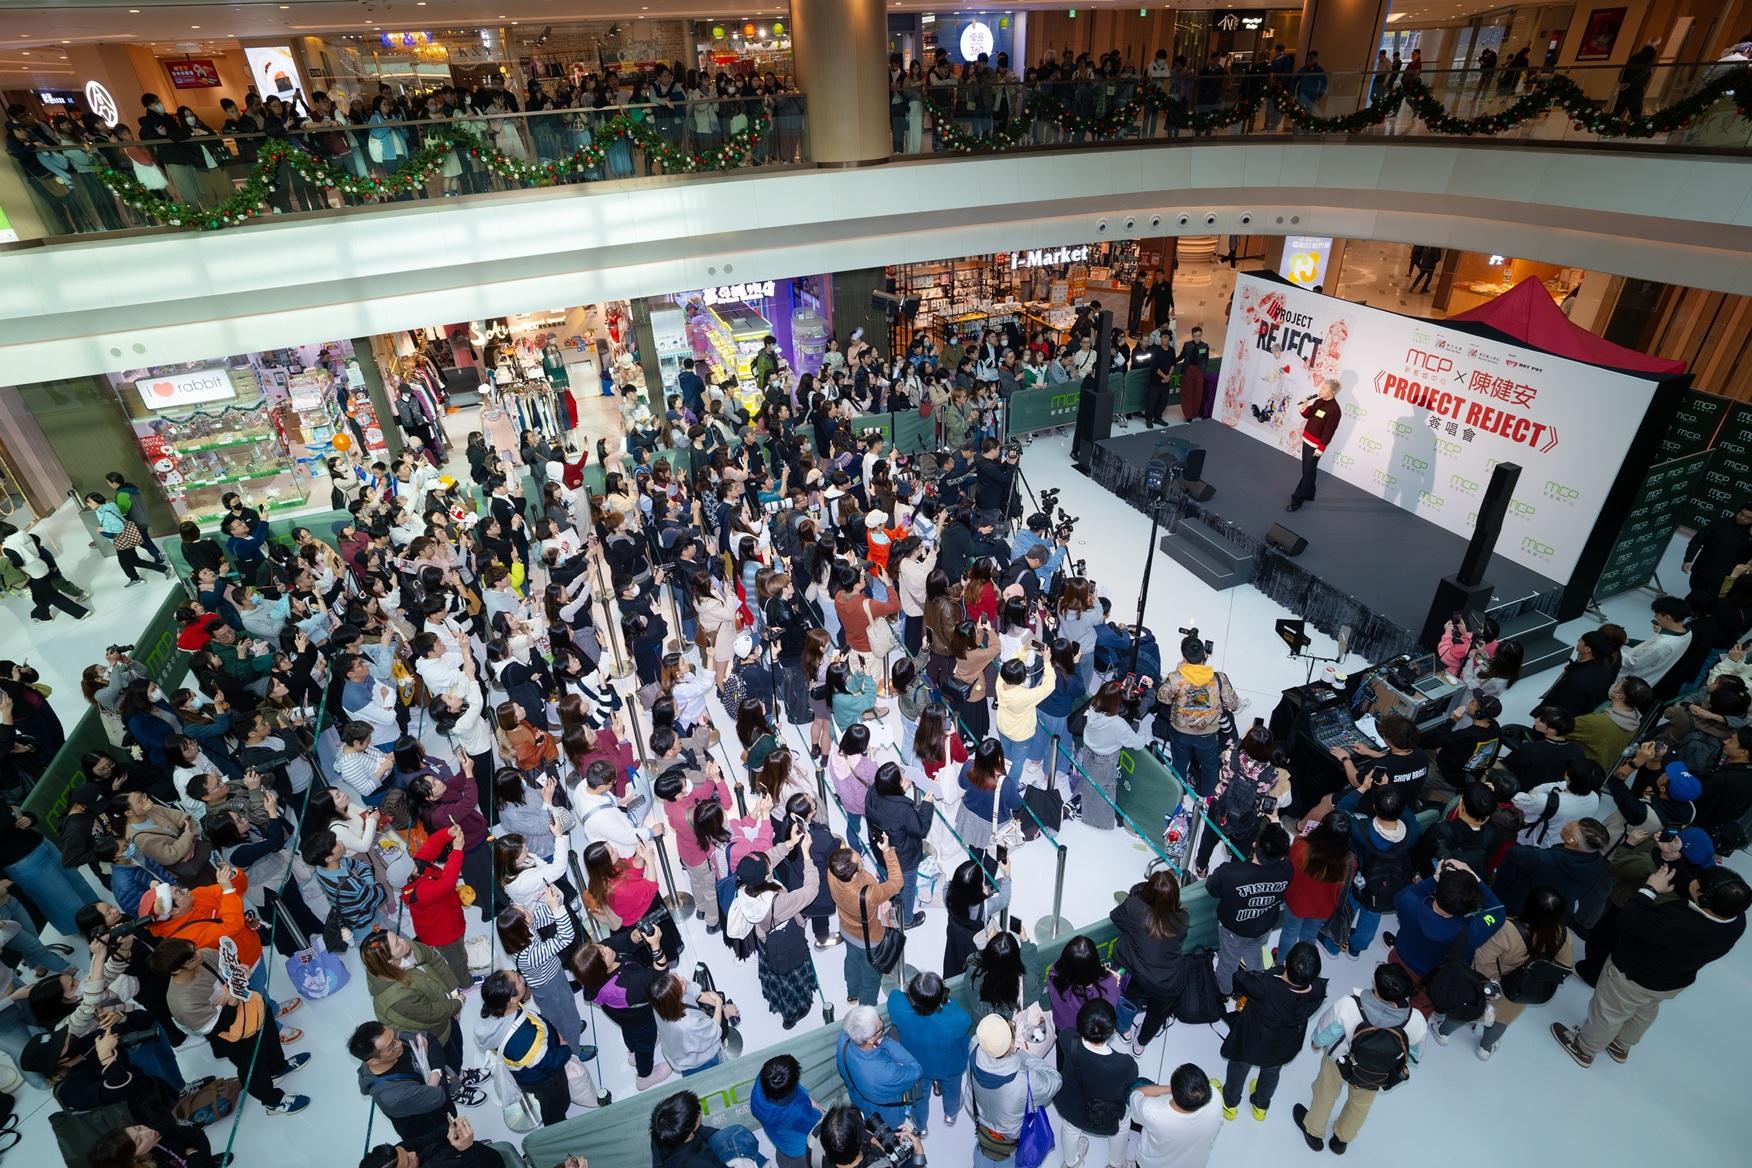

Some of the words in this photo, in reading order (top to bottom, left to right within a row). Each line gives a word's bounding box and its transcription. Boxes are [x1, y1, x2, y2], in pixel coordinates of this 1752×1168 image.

[1275, 304, 1313, 329] PROJECT
[178, 376, 222, 392] rabbit
[1468, 370, 1538, 410] 陳健安
[1394, 772, 1412, 782] SHOW
